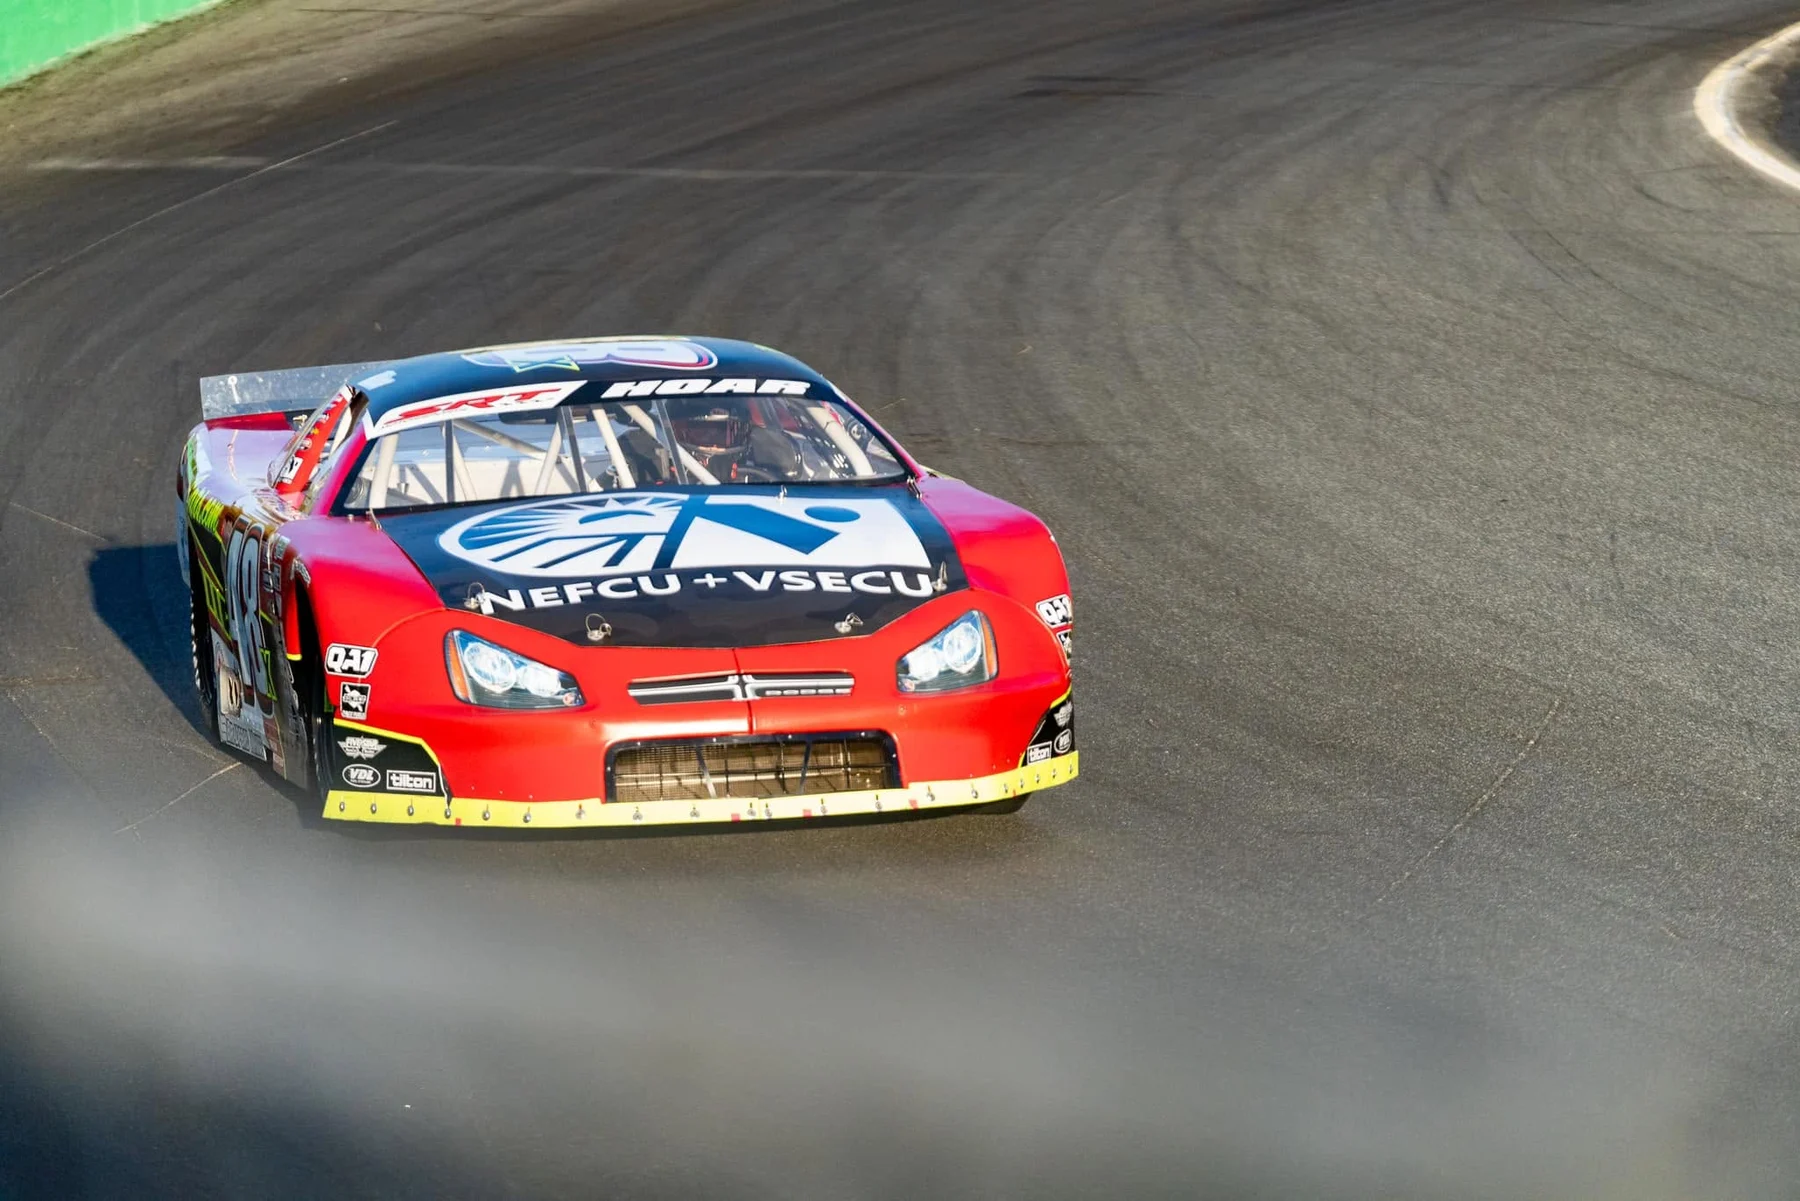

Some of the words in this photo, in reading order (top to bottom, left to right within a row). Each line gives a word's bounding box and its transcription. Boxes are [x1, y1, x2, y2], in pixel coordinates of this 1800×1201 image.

[600, 378, 811, 399] HOAR
[384, 388, 562, 426] SRT
[481, 573, 682, 616] NEFCU
[732, 570, 934, 598] VSECU
[327, 645, 376, 673] QA1
[349, 768, 374, 781] VDL
[390, 773, 432, 789] tilton
